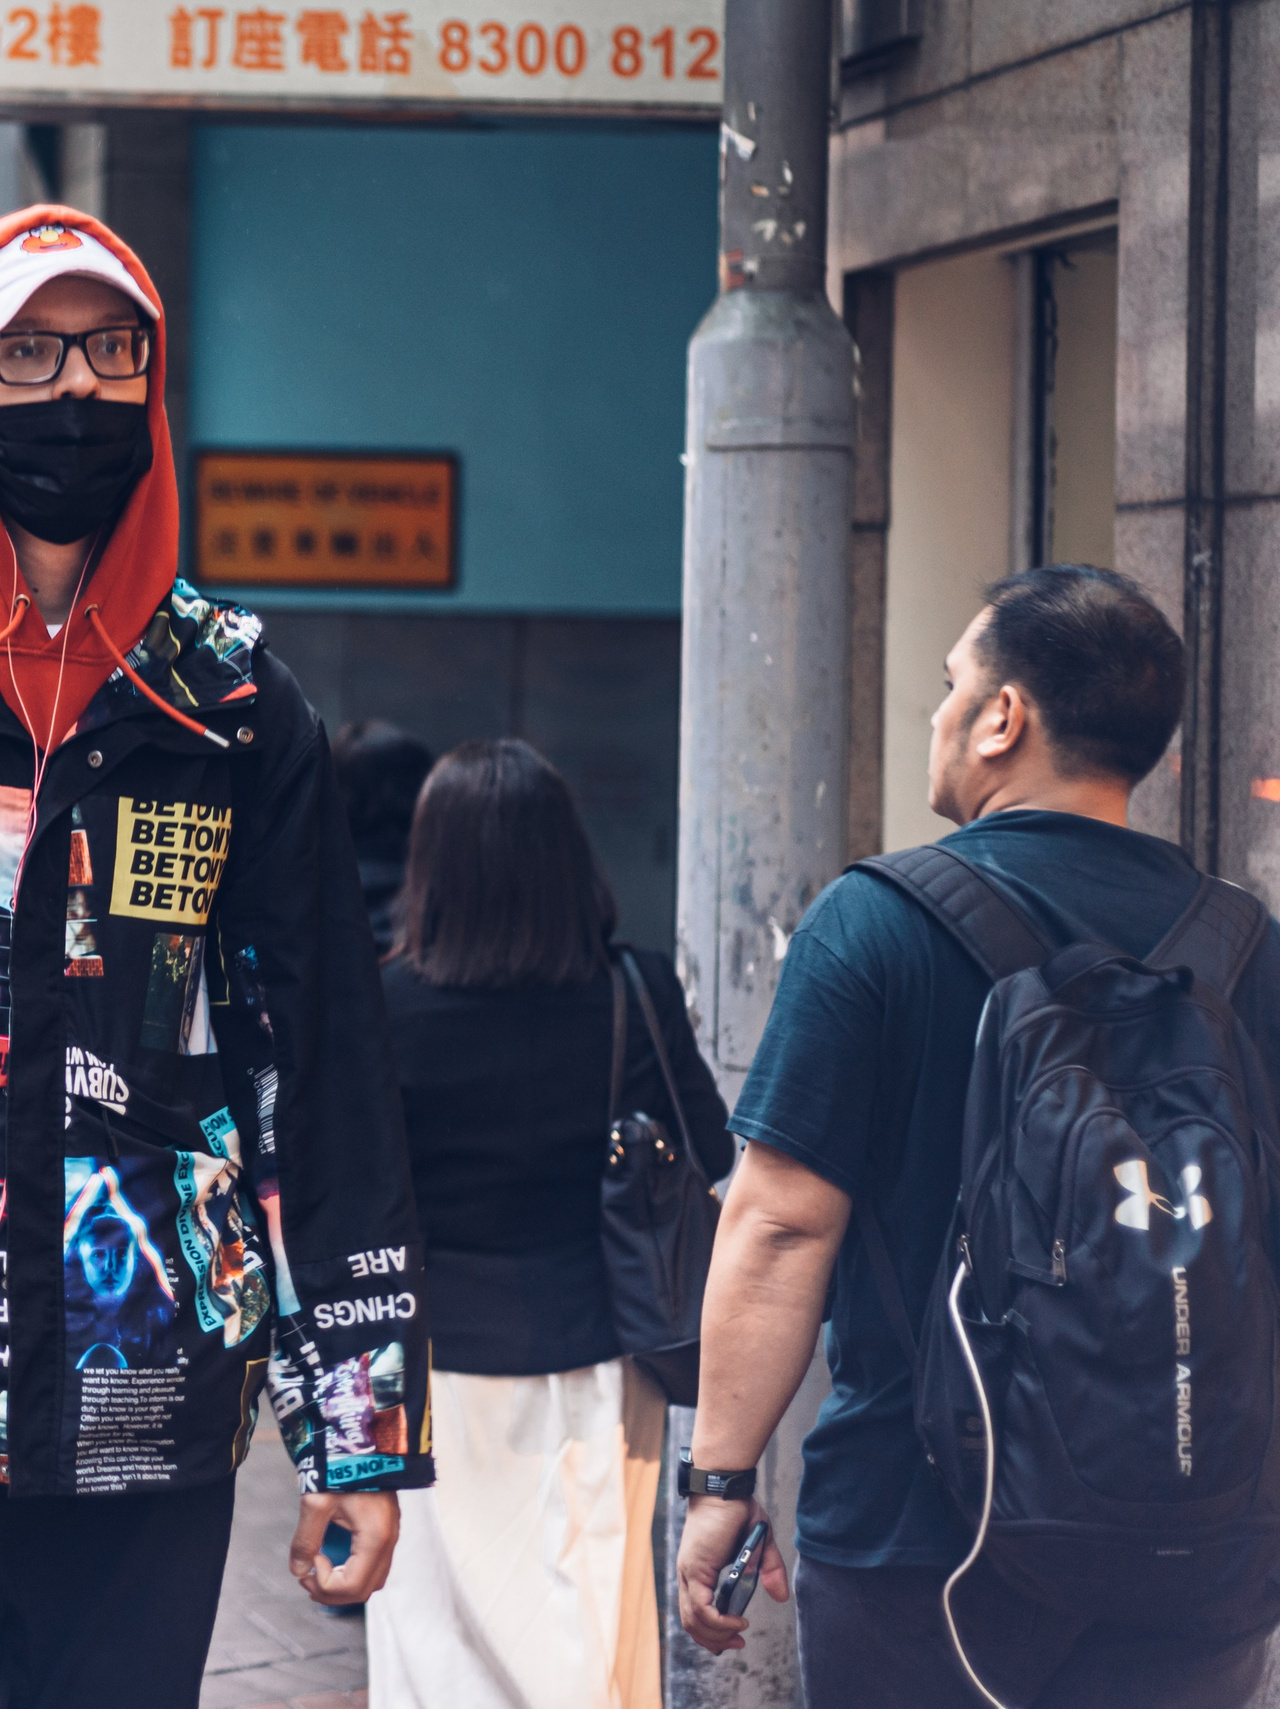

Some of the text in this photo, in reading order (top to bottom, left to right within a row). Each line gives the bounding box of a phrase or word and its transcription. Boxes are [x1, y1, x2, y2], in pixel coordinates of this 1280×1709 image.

[168, 8, 414, 75] 訂座電話
[436, 20, 588, 78] 8300
[609, 26, 719, 80] 812
[179, 1183, 193, 1235] DIVINE
[184, 1239, 217, 1327] EXPRESSION
[347, 1246, 406, 1278] ARE
[313, 1292, 417, 1329] CHNGS
[1172, 1266, 1191, 1356] UNDER
